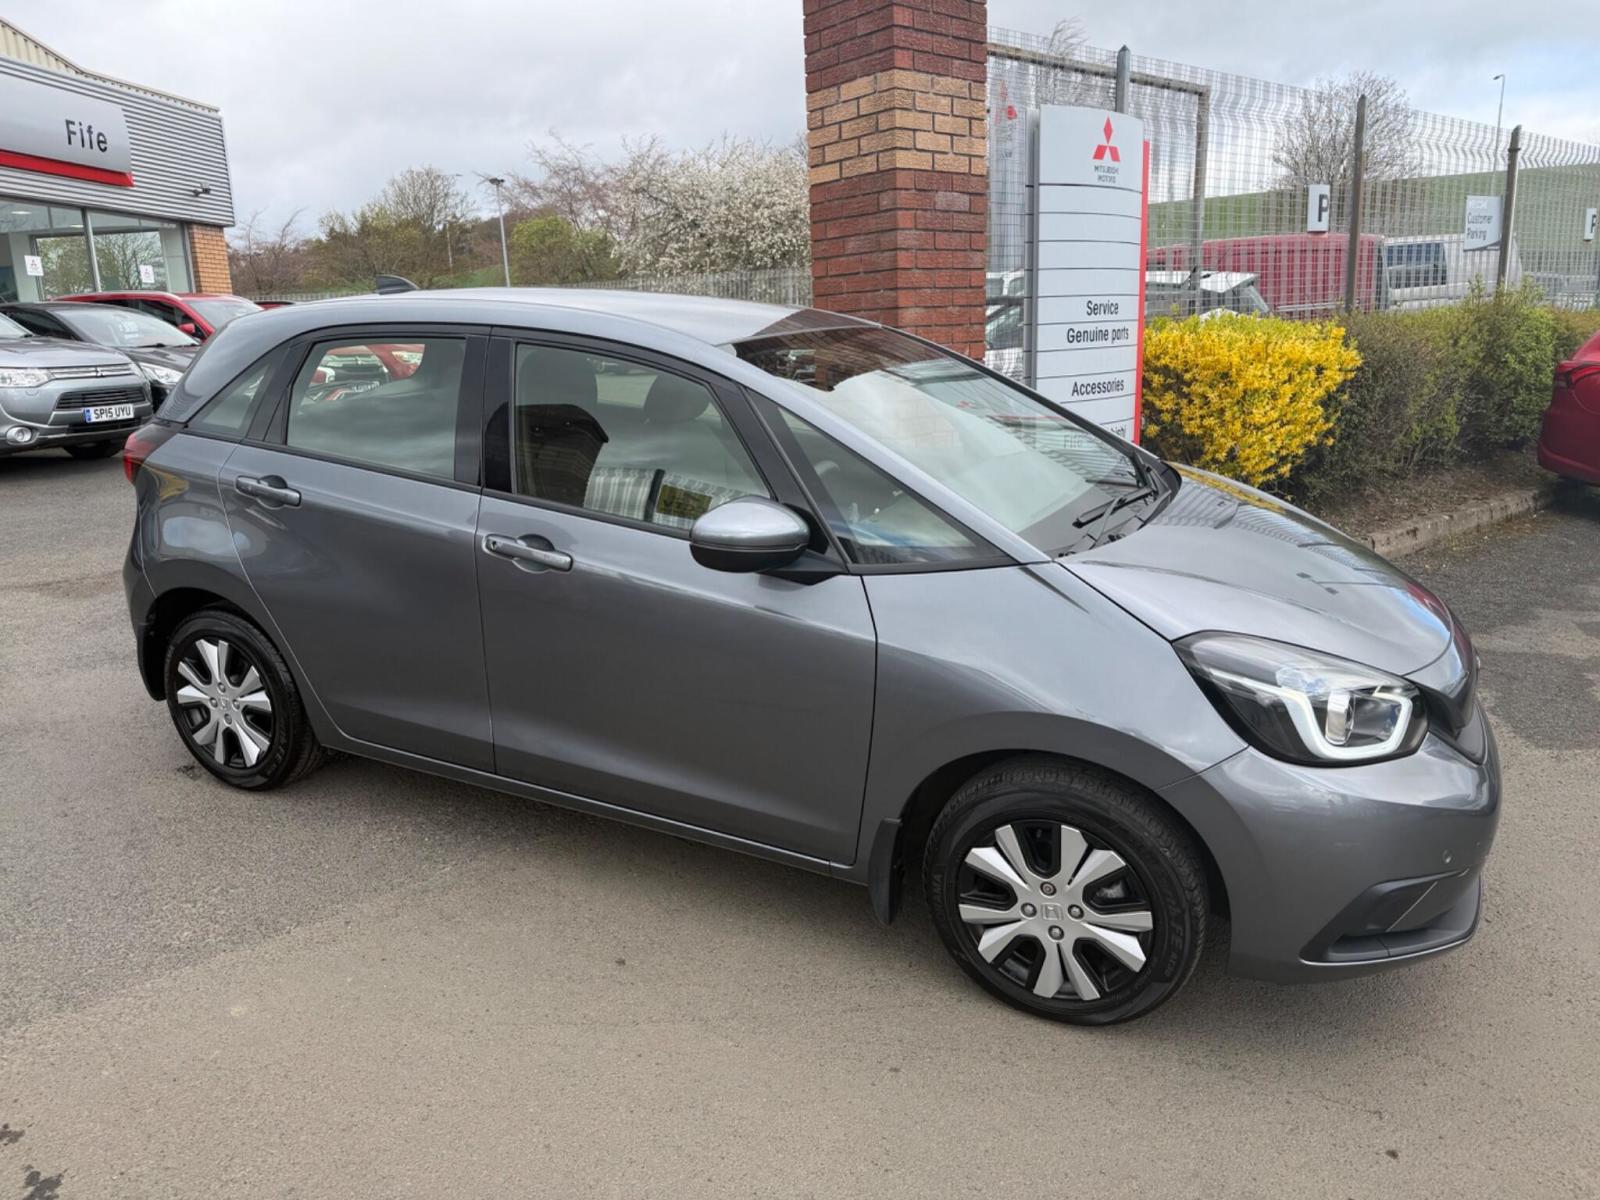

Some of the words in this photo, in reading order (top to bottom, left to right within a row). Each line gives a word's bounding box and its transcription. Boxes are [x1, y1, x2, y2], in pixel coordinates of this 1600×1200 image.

[65, 119, 108, 153] Fife
[1318, 193, 1329, 222] P
[1086, 300, 1119, 316] Service
[1066, 327, 1109, 343] Genuine
[1111, 326, 1129, 344] parts
[1071, 378, 1125, 397] Accessories
